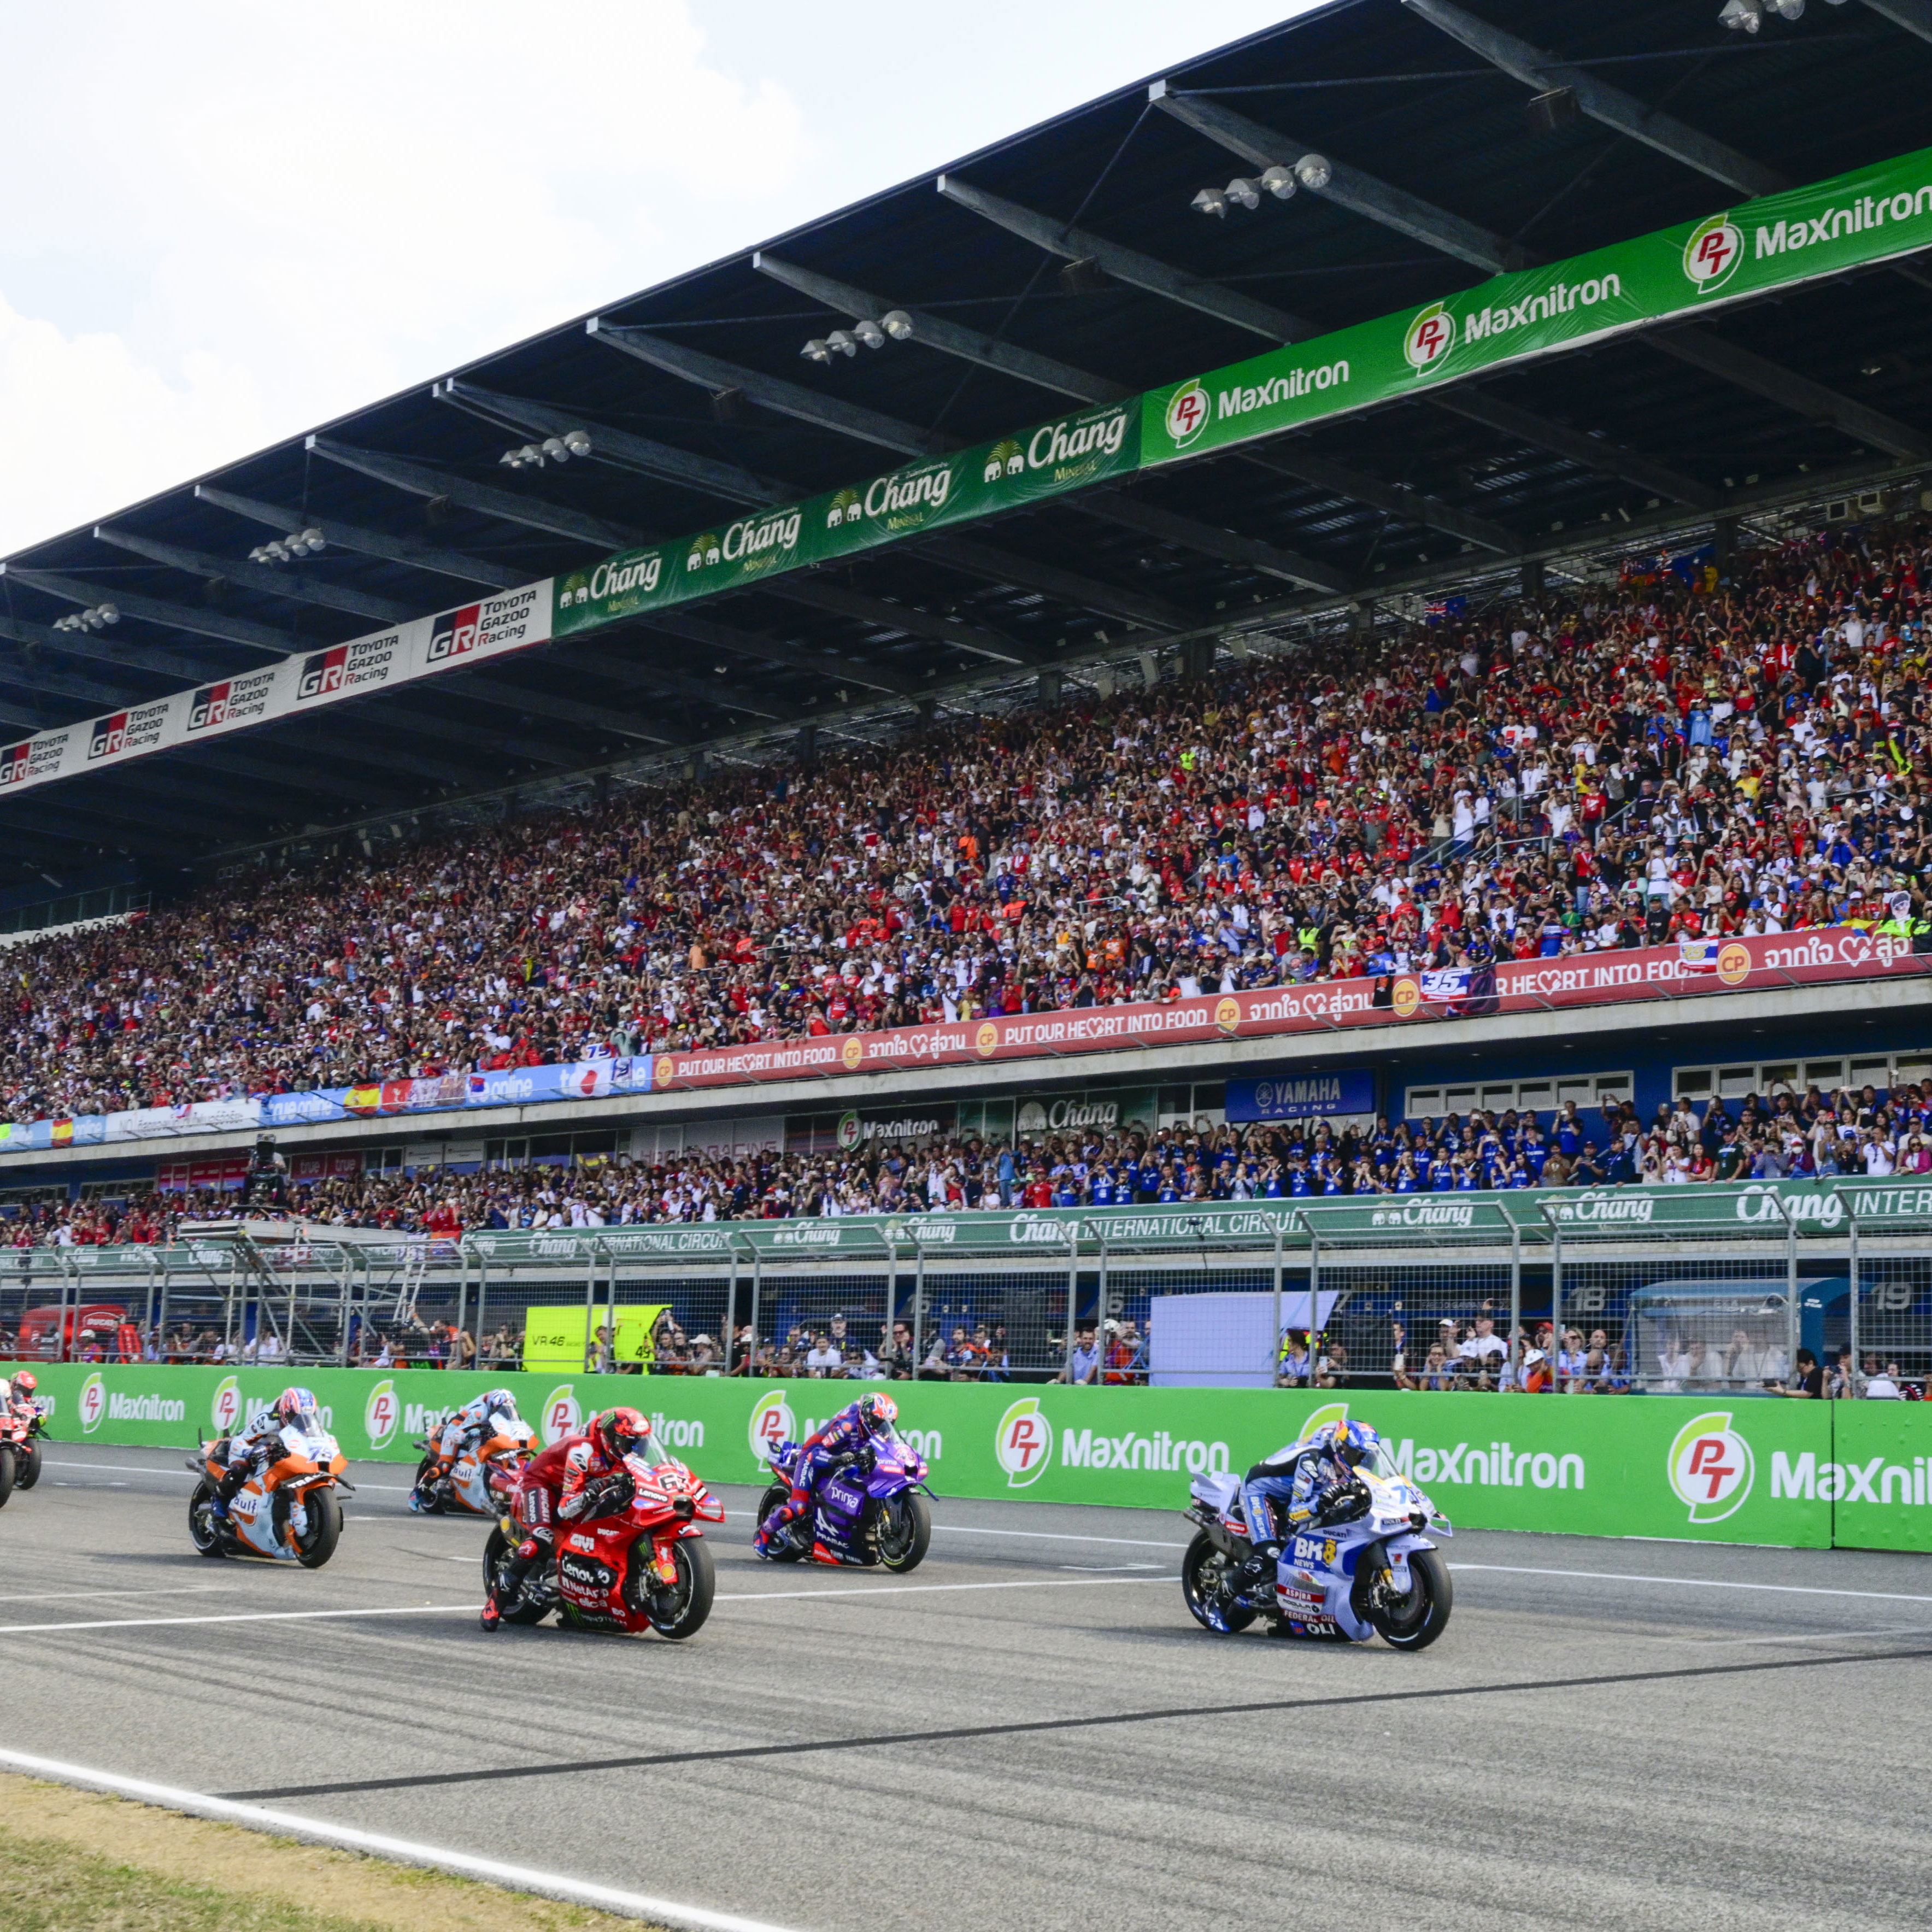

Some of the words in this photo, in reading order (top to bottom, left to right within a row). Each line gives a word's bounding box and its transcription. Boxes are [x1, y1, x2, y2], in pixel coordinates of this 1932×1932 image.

[1755, 185, 1932, 259] Maxnitron
[1465, 273, 1620, 344] Maxnitron
[1218, 360, 1349, 420] Maxnitron
[1027, 414, 1127, 469] Chang
[864, 468, 953, 516] Chang
[722, 513, 803, 561] Chang
[591, 557, 662, 600] Chang
[484, 590, 537, 614] TOYOTA
[480, 607, 530, 631] GAZOO
[350, 635, 399, 656] TOYOTA
[428, 624, 476, 659] GR
[478, 624, 526, 646] Racing
[347, 650, 392, 671] GAZOO
[233, 672, 275, 692] TOYOTA
[300, 664, 344, 697] GR
[345, 666, 388, 685] Racing
[230, 687, 268, 706] GAZOO
[130, 703, 168, 723] TOYOTA
[190, 700, 227, 727] GR
[226, 702, 264, 720] Racing
[127, 718, 163, 735] GAZOO
[31, 733, 69, 751] TOYOTA
[90, 730, 122, 756] GR
[124, 731, 160, 749] Racing
[29, 747, 63, 764] GAZOO
[0, 763, 28, 783] GR
[26, 760, 60, 777] Racing
[1594, 962, 1642, 986] INTO
[1722, 955, 1745, 971] CP
[1423, 971, 1462, 993] 35
[1250, 995, 1300, 1020] จากใจ
[1396, 990, 1413, 1005] CP
[1006, 1027, 1033, 1044] PUT
[1035, 1024, 1065, 1041] OUR
[1128, 1012, 1162, 1032] INTO
[1166, 1008, 1207, 1028] FOOD
[1220, 1008, 1236, 1021] CP
[869, 1038, 907, 1057] จากใจ
[980, 1033, 995, 1046] CP
[678, 1061, 700, 1076] PUT
[702, 1058, 725, 1074] OUR
[774, 1052, 801, 1068] INTO
[803, 1048, 835, 1065] FOOD
[845, 1047, 859, 1059] CP
[492, 1075, 533, 1101] online
[1275, 1078, 1340, 1104] YAMAHA
[1261, 1104, 1336, 1114] RACING
[863, 1118, 939, 1140] Maxnitron
[1402, 1197, 1475, 1228] Chang
[1576, 1192, 1654, 1223] Chang
[1737, 1185, 1843, 1228] Chang
[1010, 1213, 1079, 1248] Chang
[1571, 1286, 1606, 1311] 18
[1873, 1282, 1912, 1310] 19
[109, 1393, 184, 1421] Maxnitron
[1062, 1429, 1229, 1473] Maxnitron
[1771, 1451, 1932, 1505] Maxni
[638, 1488, 668, 1502] Lenovo
[831, 1487, 859, 1508] prima
[570, 1534, 595, 1551] GIVI
[1323, 1529, 1347, 1538] DUCATI
[1294, 1537, 1337, 1565] BK8
[562, 1555, 610, 1584] Lenovo
[1294, 1558, 1314, 1569] NEWS
[1285, 1589, 1312, 1601] ASPIRA
[1284, 1610, 1318, 1623] FEDERAL
[1321, 1615, 1336, 1623] OIL
